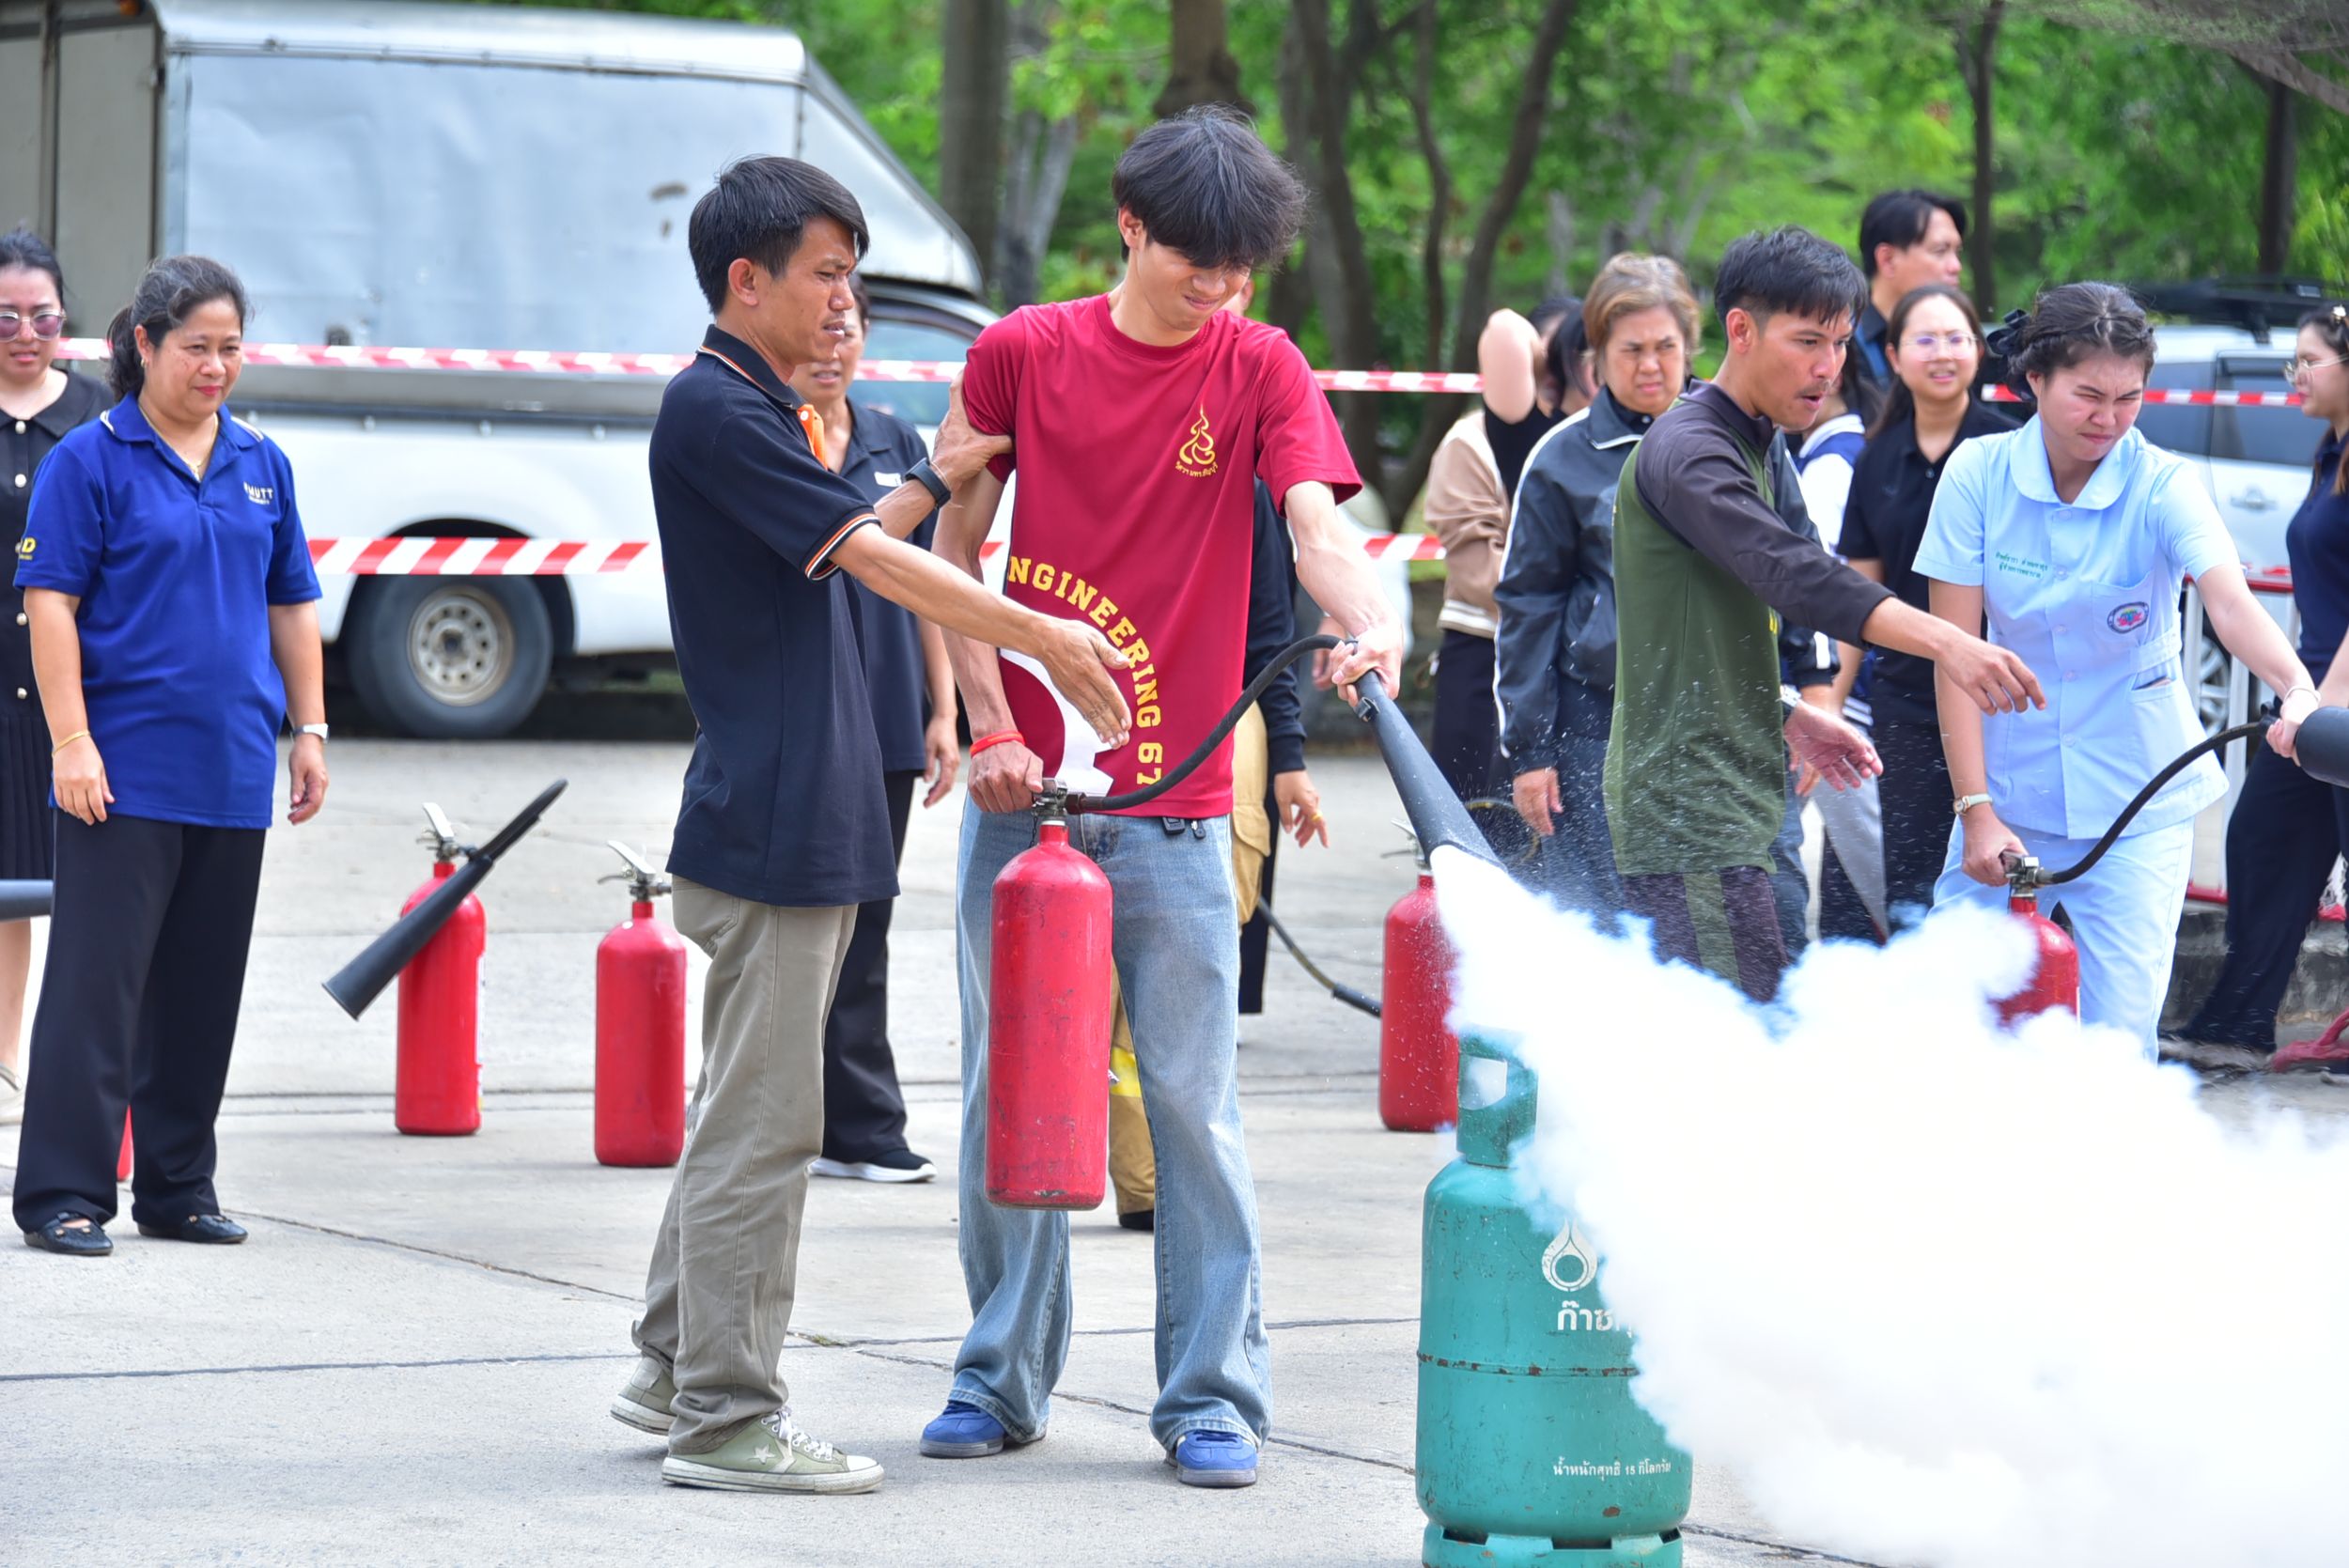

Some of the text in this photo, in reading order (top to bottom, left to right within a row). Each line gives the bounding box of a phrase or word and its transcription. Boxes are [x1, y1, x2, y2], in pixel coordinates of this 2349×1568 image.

[1008, 555, 1162, 785] NGINEERING 67
[1625, 1465, 1636, 1476] 15
